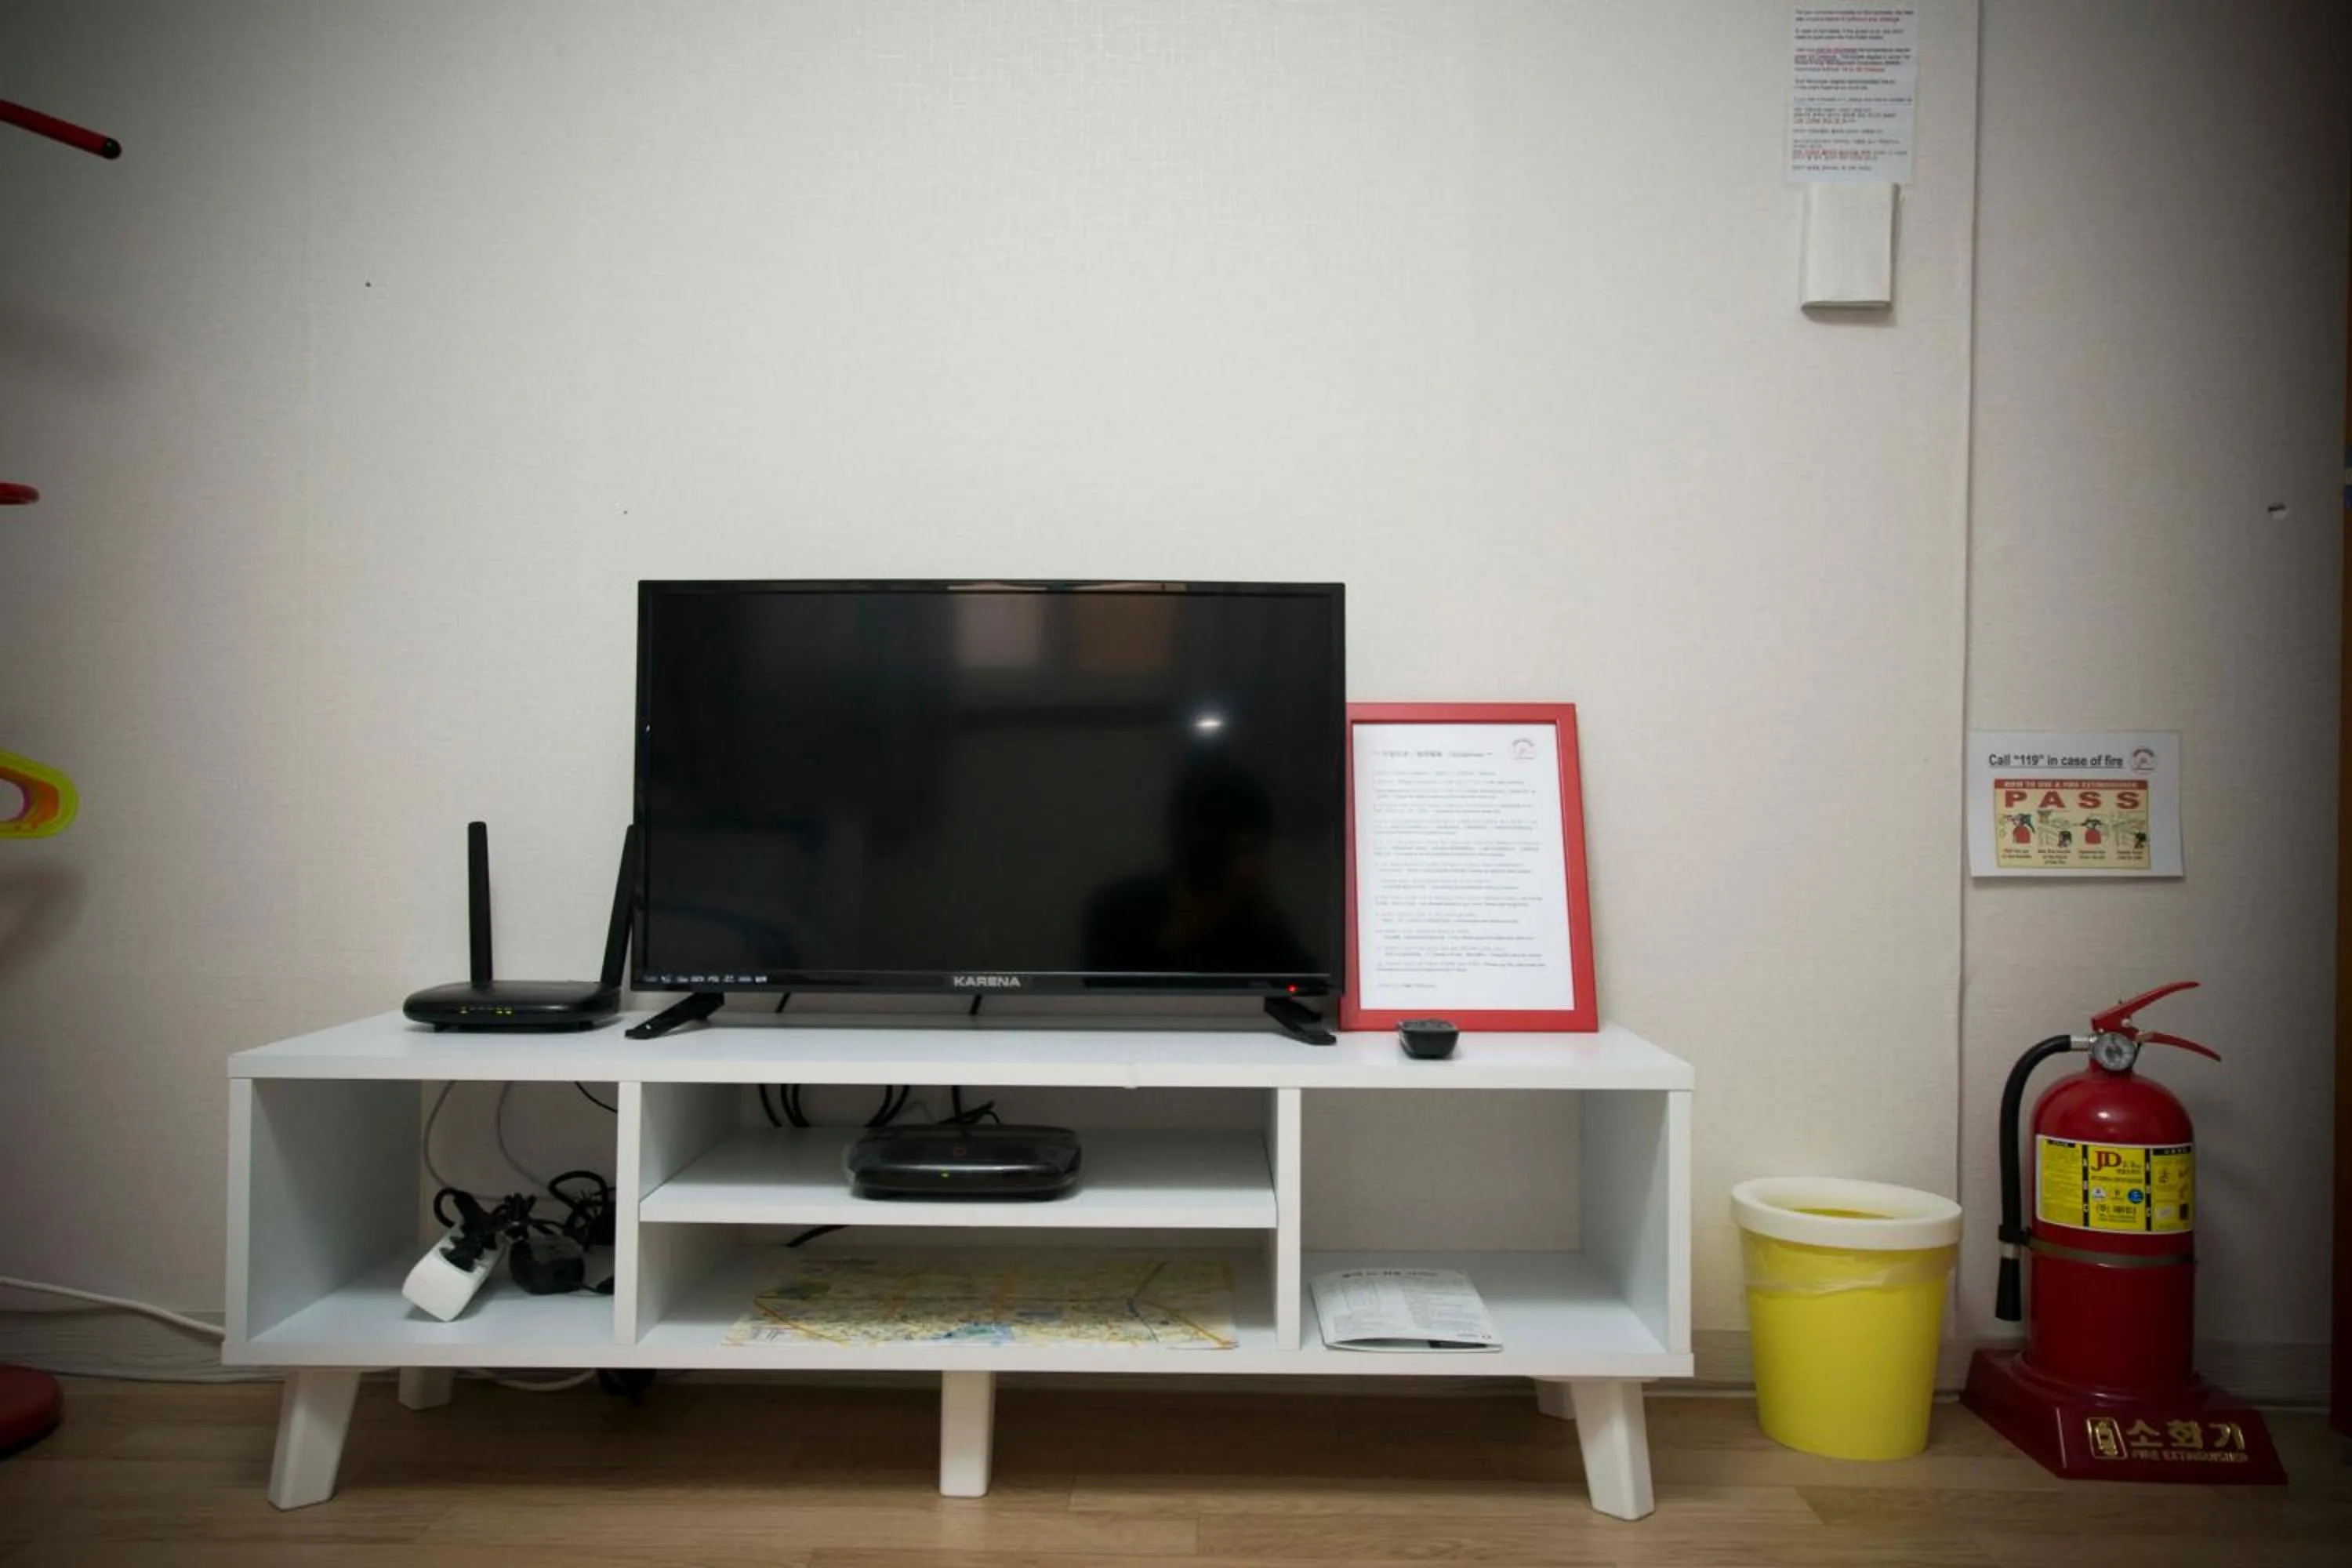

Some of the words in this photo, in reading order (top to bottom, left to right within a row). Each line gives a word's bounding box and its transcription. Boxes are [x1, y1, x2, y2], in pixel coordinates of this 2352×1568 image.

[1989, 753, 2011, 767] Call
[2047, 753, 2058, 766] in
[2061, 756, 2087, 766] case
[2089, 753, 2102, 766] of
[2104, 754, 2124, 766] fire
[953, 976, 1021, 987] KARENA
[2091, 1151, 2122, 1171] JD
